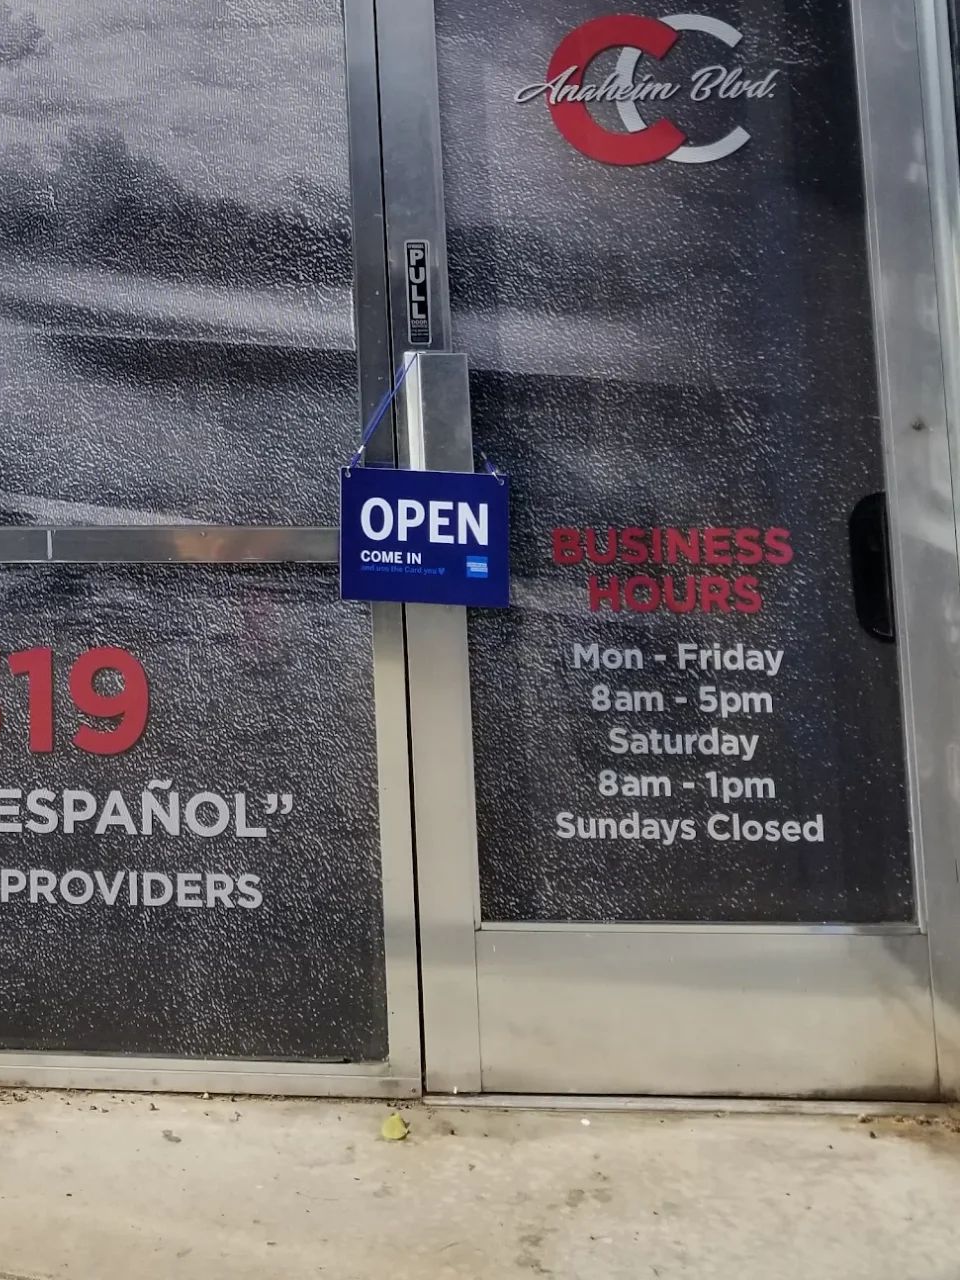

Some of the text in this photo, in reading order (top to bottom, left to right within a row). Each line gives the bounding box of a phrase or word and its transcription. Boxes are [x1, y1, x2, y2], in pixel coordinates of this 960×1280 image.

[514, 65, 780, 105] Anaheim Blvd.
[409, 249, 426, 319] PULL
[360, 497, 488, 546] OPEN
[360, 550, 422, 565] COME IN
[552, 527, 793, 565] BUSINESS
[391, 565, 402, 573] the
[404, 566, 422, 574] Card
[424, 567, 437, 575] you
[590, 575, 762, 613] HOURS
[573, 643, 643, 670] Mon
[678, 643, 784, 676] Friday
[591, 684, 664, 712] 8am
[699, 686, 773, 718] 5pm
[609, 727, 759, 760] Saturday
[598, 770, 671, 797] 8am
[706, 772, 775, 803] 1pm
[556, 812, 825, 845] Sundays Closed
[0, 869, 264, 909] PROVIDERS
